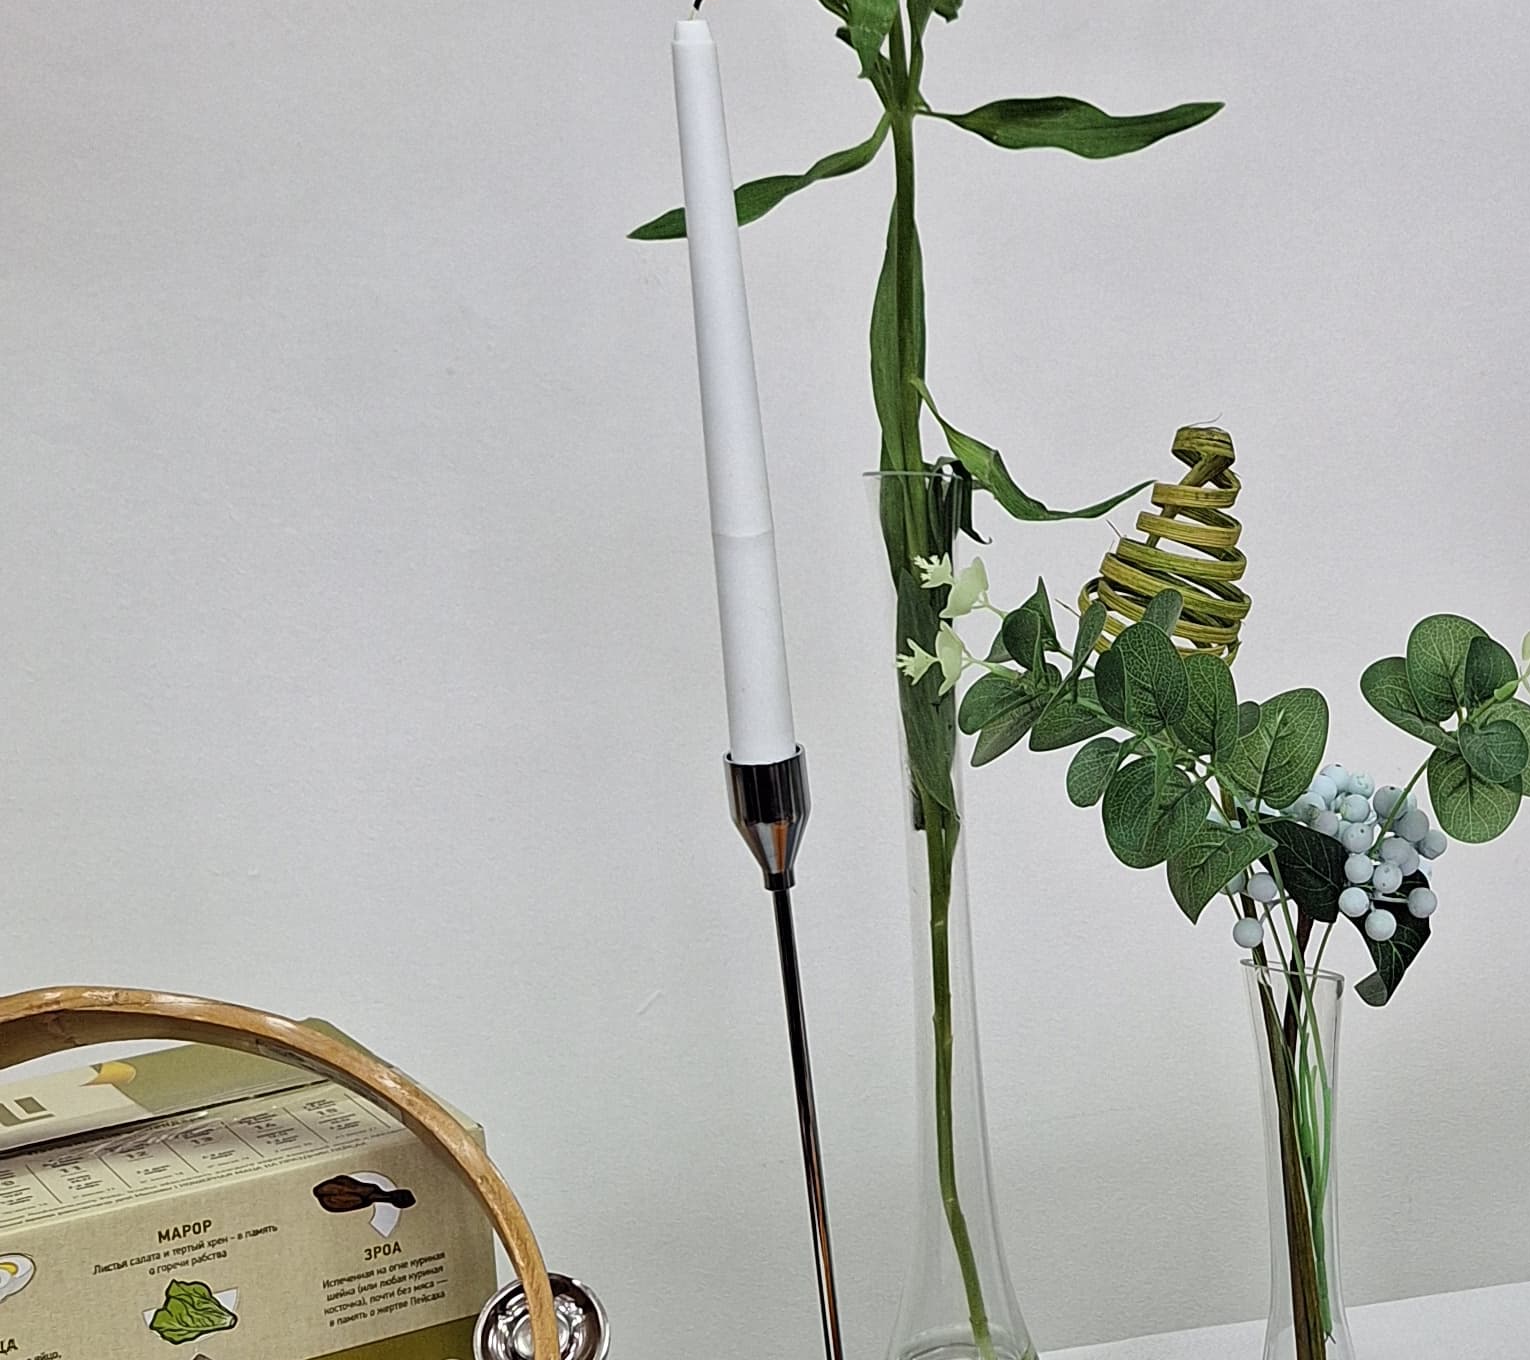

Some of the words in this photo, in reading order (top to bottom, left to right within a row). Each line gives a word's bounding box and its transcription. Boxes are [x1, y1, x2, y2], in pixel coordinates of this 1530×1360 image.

[158, 1219, 212, 1244] МАРОР
[92, 1259, 128, 1275] Листья
[129, 1252, 161, 1266] салата
[163, 1249, 170, 1258] и
[172, 1240, 205, 1256] тертый
[207, 1235, 228, 1249] хрен
[237, 1232, 243, 1240] в
[244, 1224, 278, 1239] память
[149, 1267, 155, 1275] о
[156, 1259, 189, 1274] горечи
[191, 1249, 227, 1267] рабства
[364, 1241, 402, 1261] ЗРОА
[377, 1267, 387, 1276] на
[388, 1262, 408, 1273] огне
[410, 1252, 445, 1268] куриная
[327, 1288, 355, 1301] шейка
[357, 1283, 377, 1294] (или
[380, 1275, 407, 1288] любая
[408, 1265, 444, 1280] куриная
[369, 1291, 395, 1303] почти
[397, 1286, 411, 1296] без
[337, 1312, 368, 1325] память
[376, 1301, 408, 1315] жертве
[410, 1291, 445, 1306] Пейсаха
